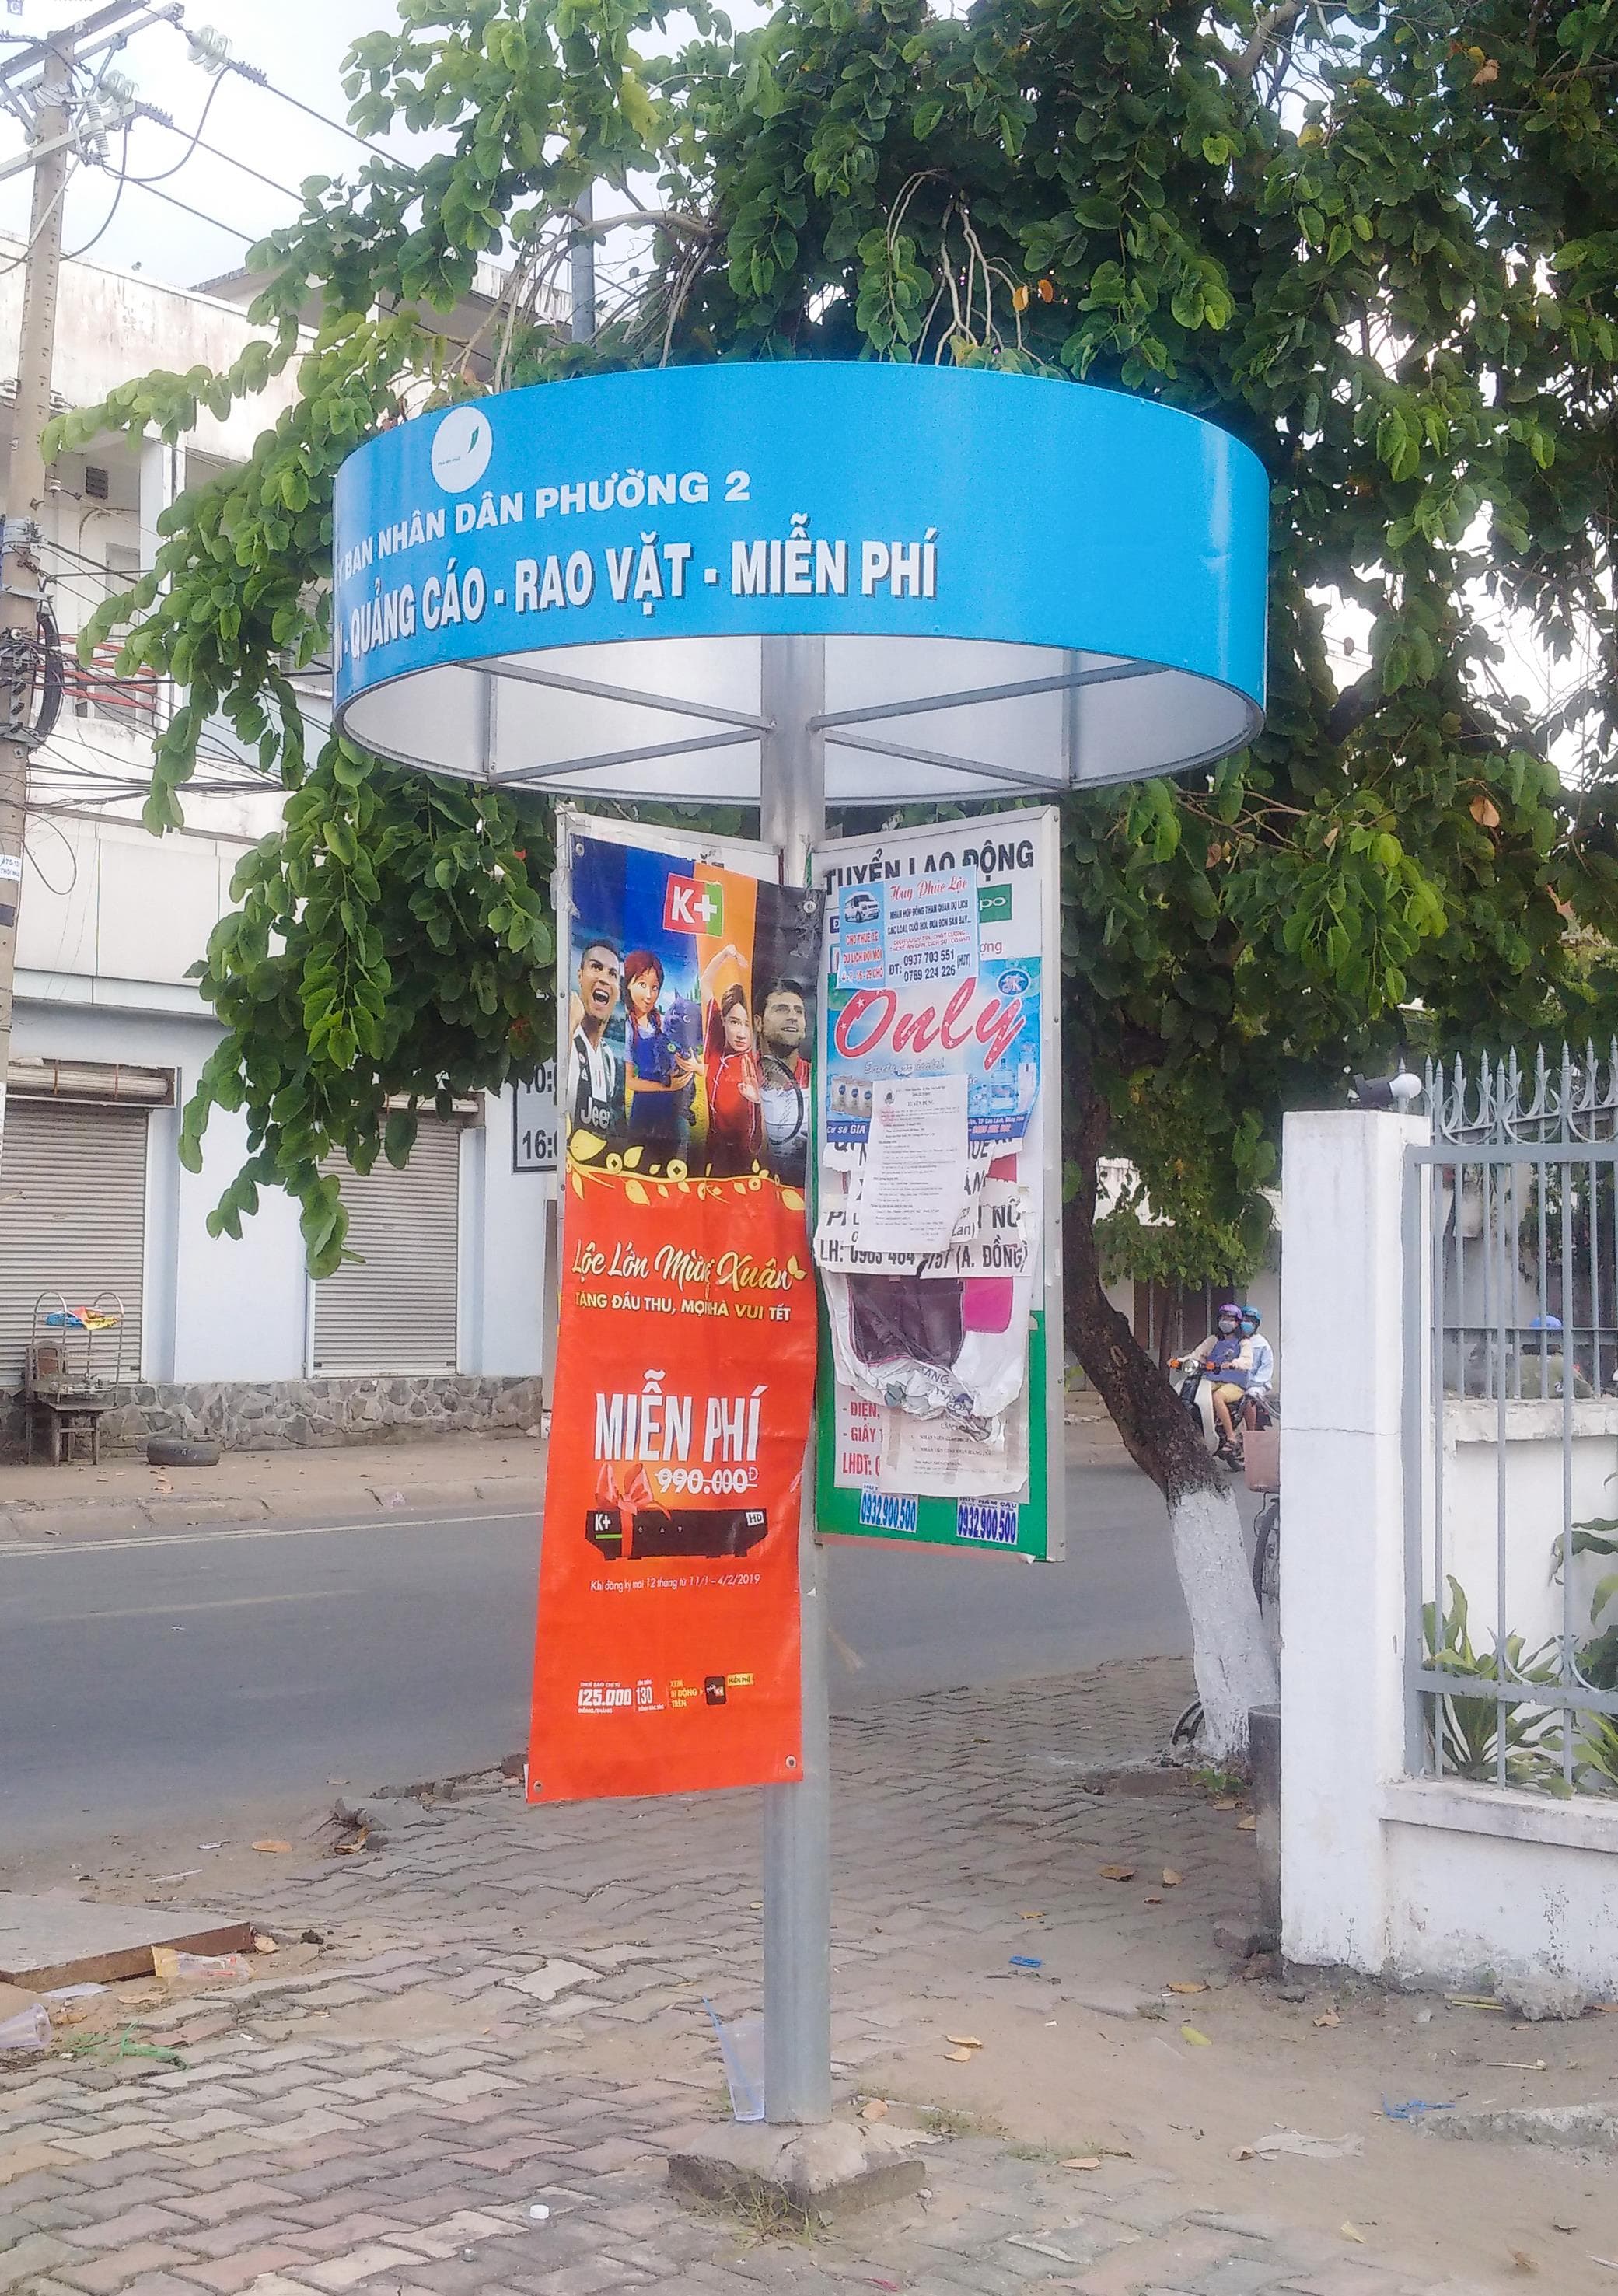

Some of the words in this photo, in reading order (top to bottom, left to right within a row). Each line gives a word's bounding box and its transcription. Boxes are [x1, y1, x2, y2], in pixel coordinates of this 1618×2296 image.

[345, 536, 373, 581] BAN
[378, 509, 446, 560] NHÂN
[455, 491, 524, 534] DÂN
[535, 469, 709, 519] PHƯỜNG
[725, 470, 750, 501] 2
[351, 576, 416, 659] QUẢNG
[421, 557, 485, 631] CÁO
[515, 550, 594, 613] RAO
[606, 531, 691, 617] VẶT
[731, 512, 848, 598] MIỄN
[861, 526, 938, 599] PHÍ
[963, 840, 1034, 882] ĐỘNG
[671, 885, 717, 924] K+
[903, 952, 922, 966] 0937
[924, 950, 938, 963] 703
[940, 949, 955, 961] 551
[903, 969, 923, 982] 0769
[925, 966, 938, 979] 224
[941, 965, 956, 977] 226
[835, 977, 1026, 1072] Only
[580, 1096, 611, 1129] Jee
[850, 1124, 865, 1134] GIA
[522, 1130, 557, 1159] 16:
[820, 1239, 844, 1263] LH:
[607, 1240, 650, 1279] Lớn
[715, 1250, 793, 1292] Xuân
[735, 1304, 764, 1320] VUI
[594, 1369, 692, 1462] MIỄN
[703, 1384, 769, 1463] PHÍ
[595, 1513, 611, 1531] K+
[748, 1513, 763, 1525] HD
[861, 1492, 916, 1531] 0932.900.500
[958, 1504, 1016, 1543] 0932.900.500
[646, 1578, 656, 1588] 12
[718, 1574, 760, 1586] 4/2/2019
[578, 1688, 632, 1706] 125.000
[636, 1686, 652, 1704] 130
